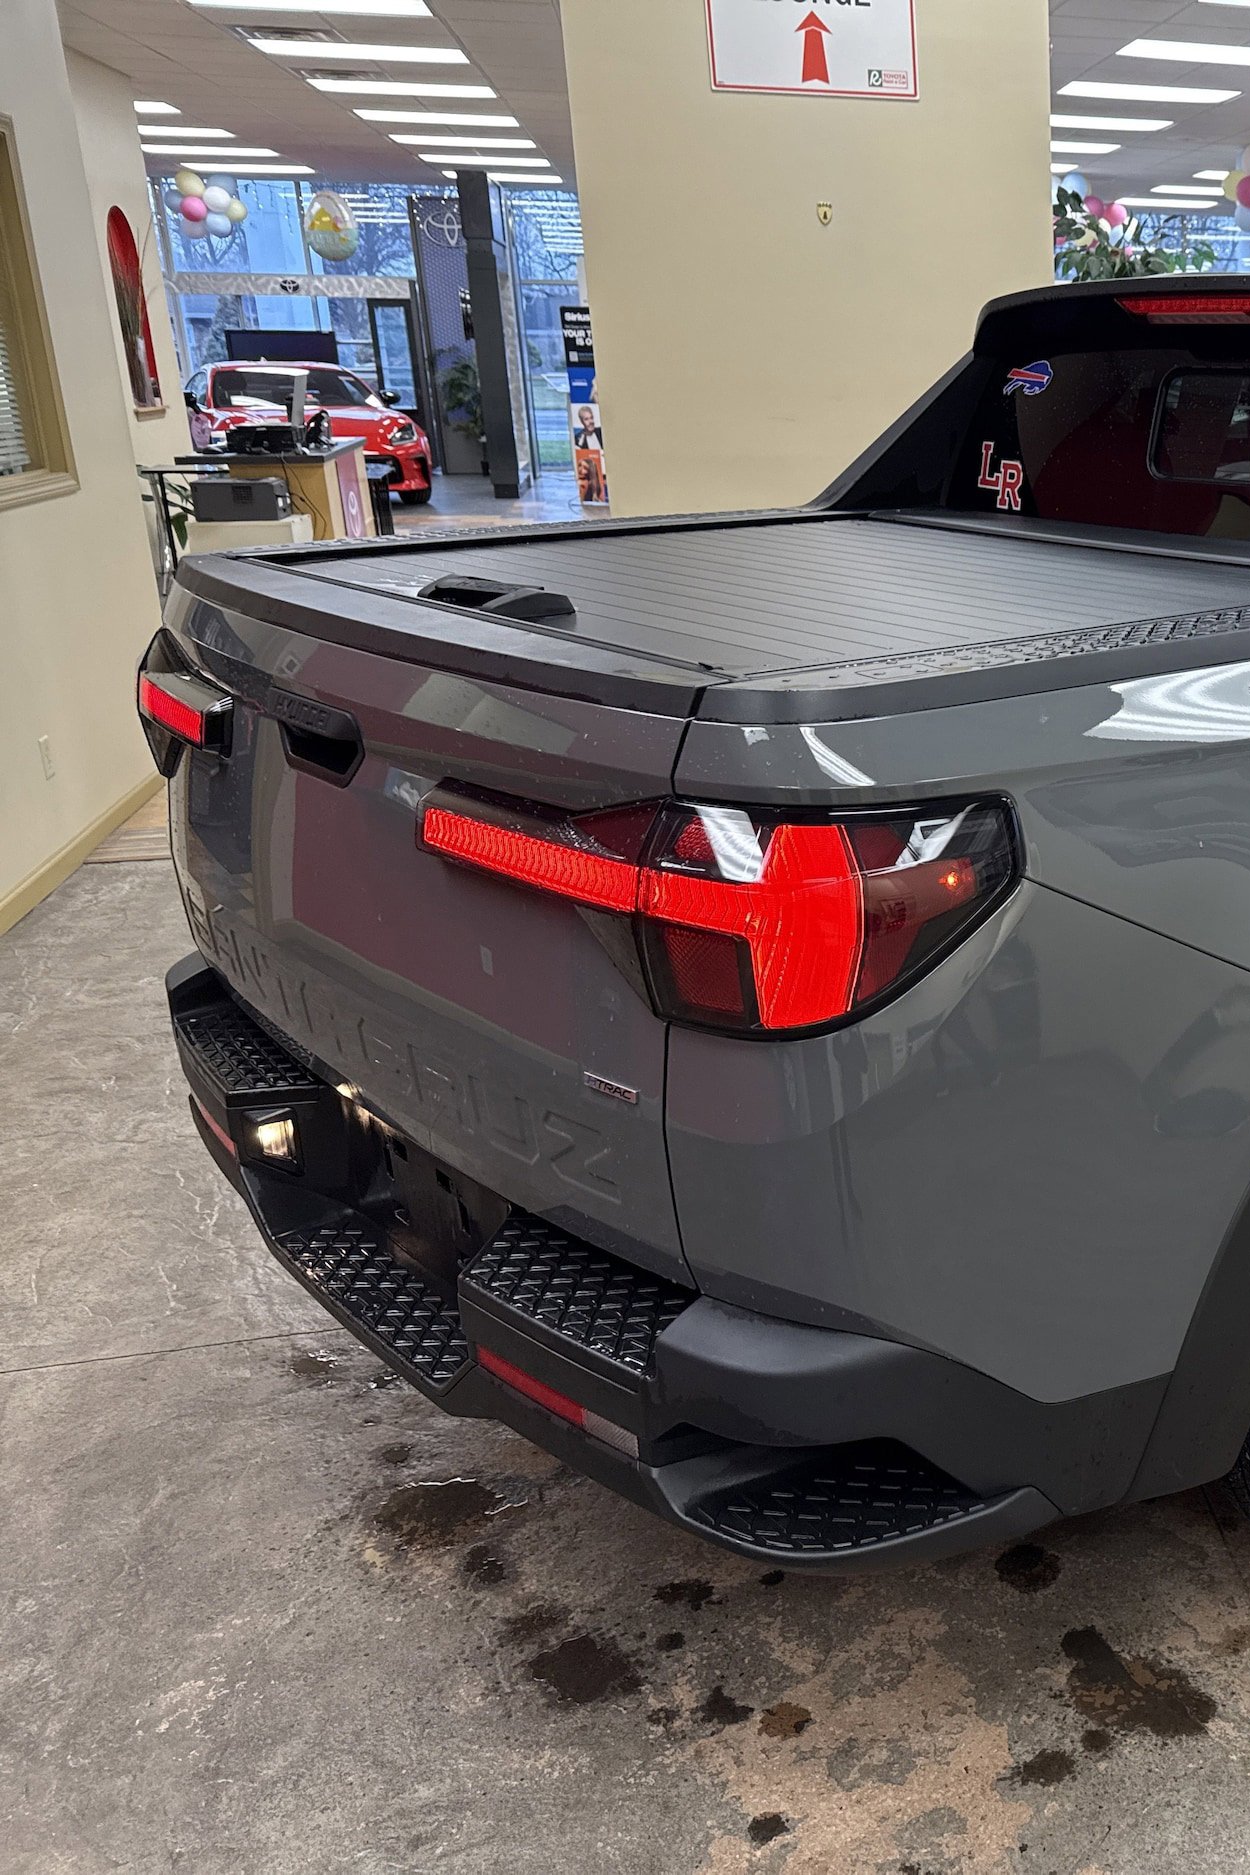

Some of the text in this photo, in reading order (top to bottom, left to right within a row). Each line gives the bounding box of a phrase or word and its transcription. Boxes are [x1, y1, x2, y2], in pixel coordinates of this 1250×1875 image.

[563, 329, 586, 338] YOUR
[585, 1074, 632, 1100] HTRAC
[357, 1016, 622, 1205] CRUZ
